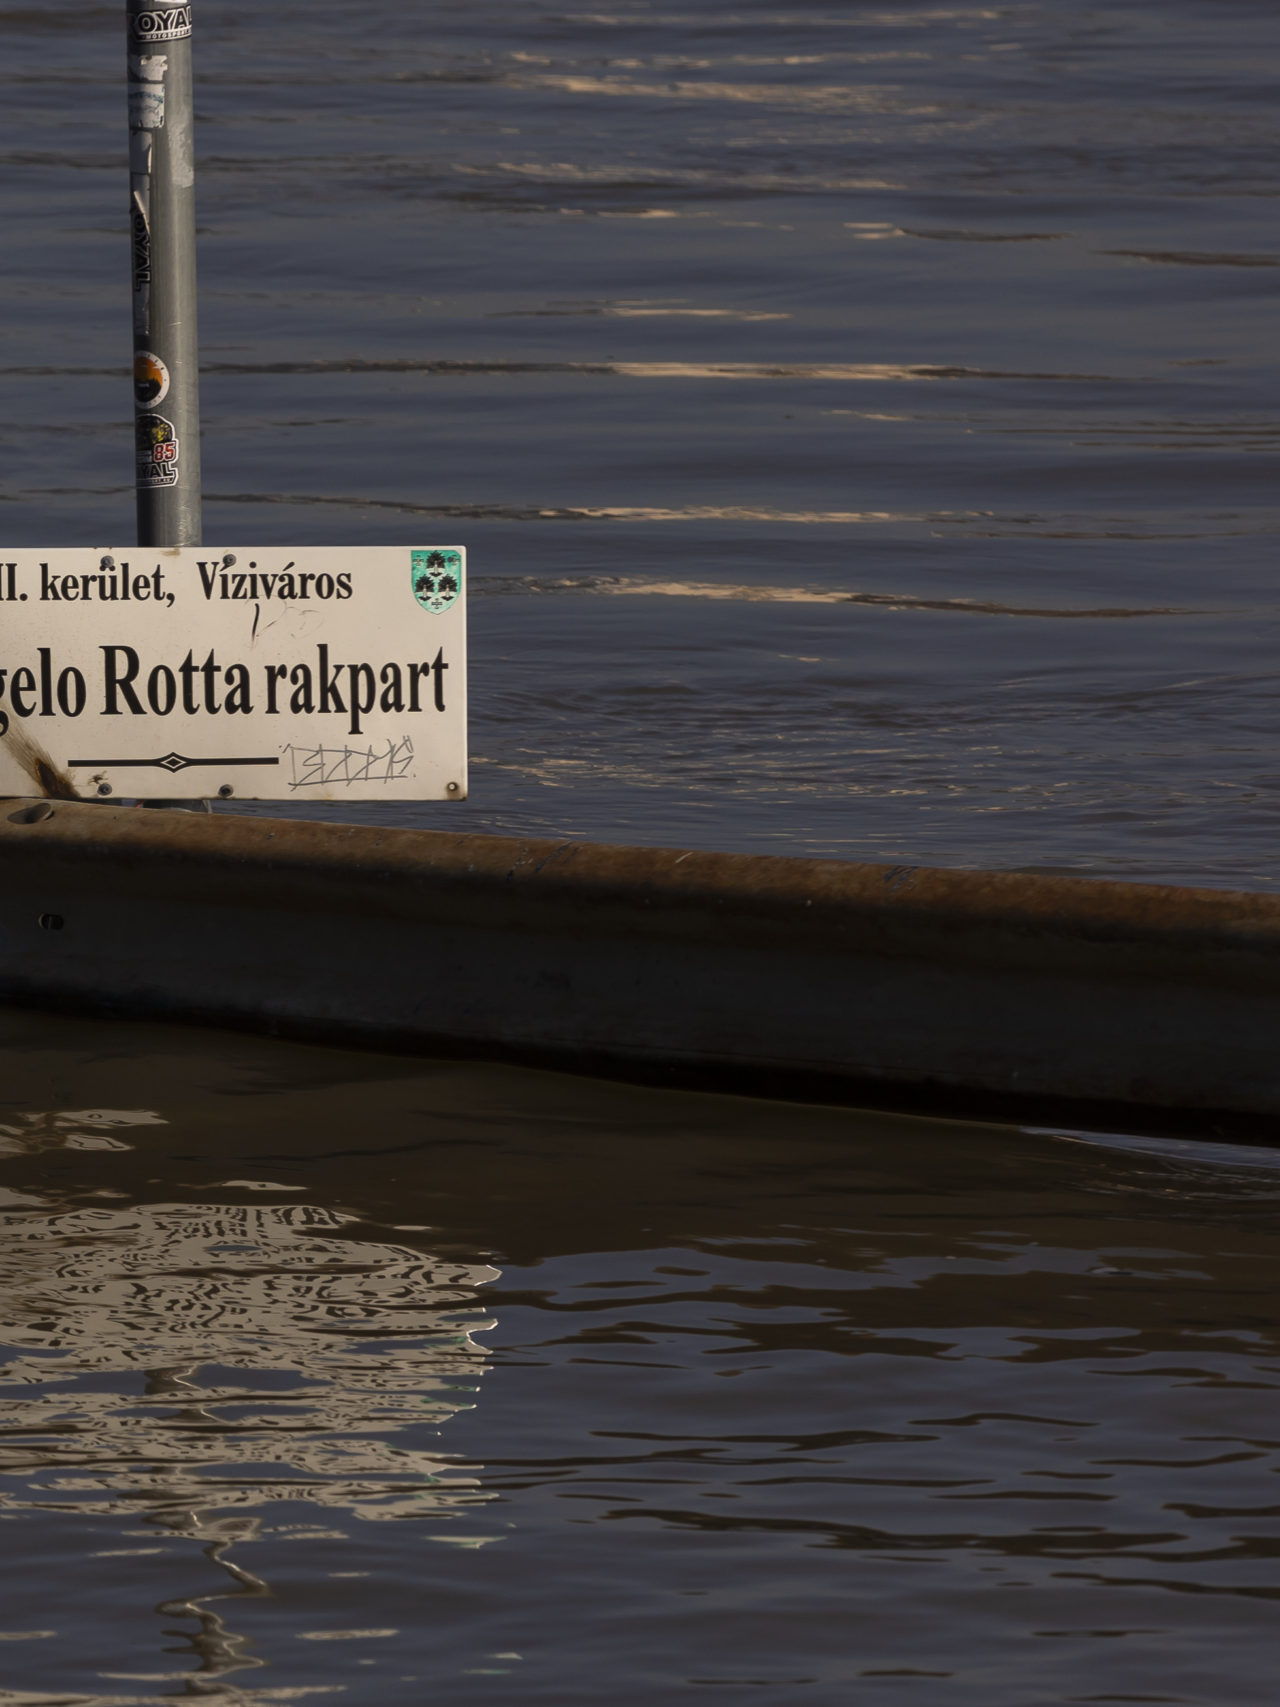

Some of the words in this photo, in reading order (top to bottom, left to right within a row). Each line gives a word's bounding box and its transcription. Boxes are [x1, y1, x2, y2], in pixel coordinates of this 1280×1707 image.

[154, 442, 175, 462] 85
[39, 562, 175, 608] kerület,
[196, 561, 353, 600] Víziváros
[98, 645, 254, 715] Rotta
[264, 643, 449, 735] rakpart
